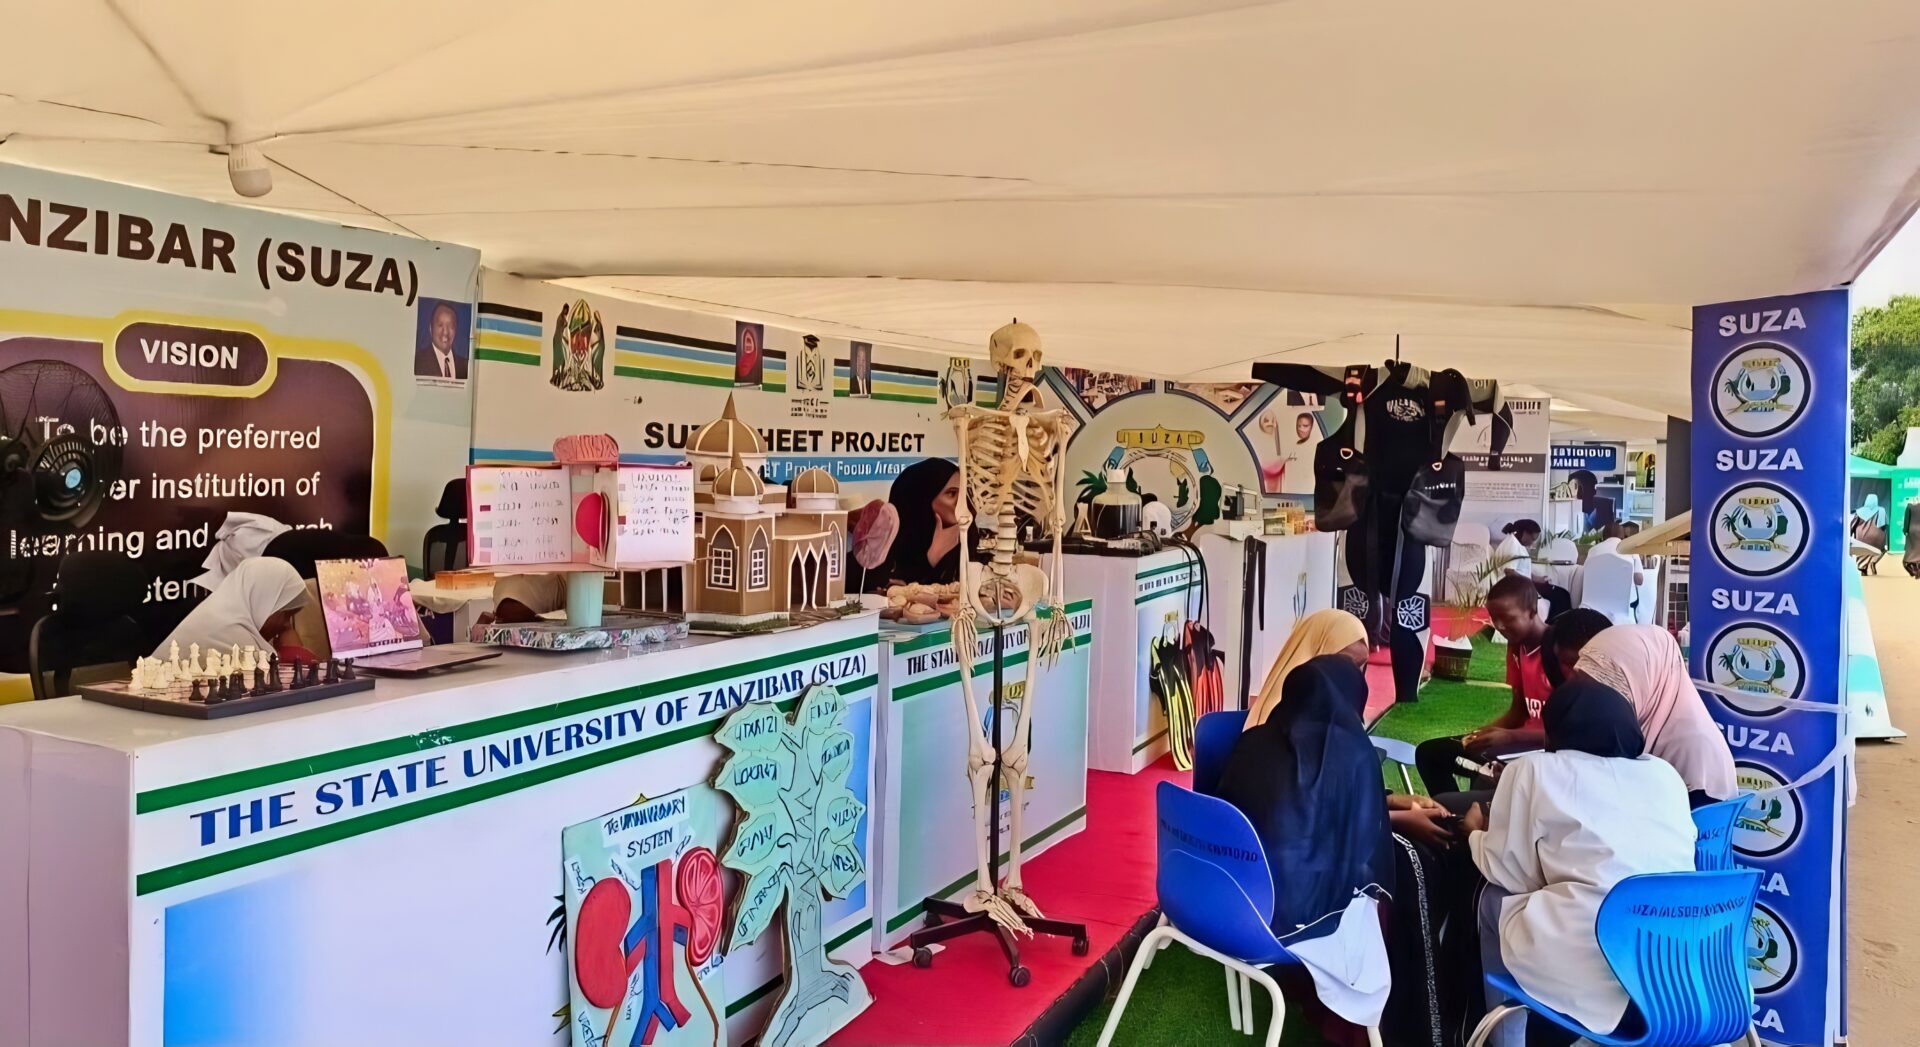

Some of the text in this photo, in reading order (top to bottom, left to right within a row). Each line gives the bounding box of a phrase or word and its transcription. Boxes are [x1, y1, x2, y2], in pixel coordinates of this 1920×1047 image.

[0, 194, 418, 307] NZIBAR (SUZA)
[1718, 307, 1806, 337] SUZA
[140, 338, 239, 370] VISION
[90, 418, 128, 448] be
[140, 419, 187, 448] the
[199, 423, 321, 454] preferred
[831, 431, 925, 453] PROJECT
[1715, 447, 1804, 472] SUZA
[152, 472, 286, 499] institution
[295, 471, 321, 497] of
[10, 522, 209, 559] learning and
[1711, 587, 1800, 616] SUZA
[907, 653, 929, 675] THE
[189, 790, 298, 847] THE
[315, 755, 448, 815] STATE
[463, 706, 647, 778] UNIVERSITY
[656, 696, 688, 727] OF
[698, 668, 804, 717] ZANZIBAR
[811, 654, 867, 687] (SUZA)
[1717, 722, 1795, 756] UZA
